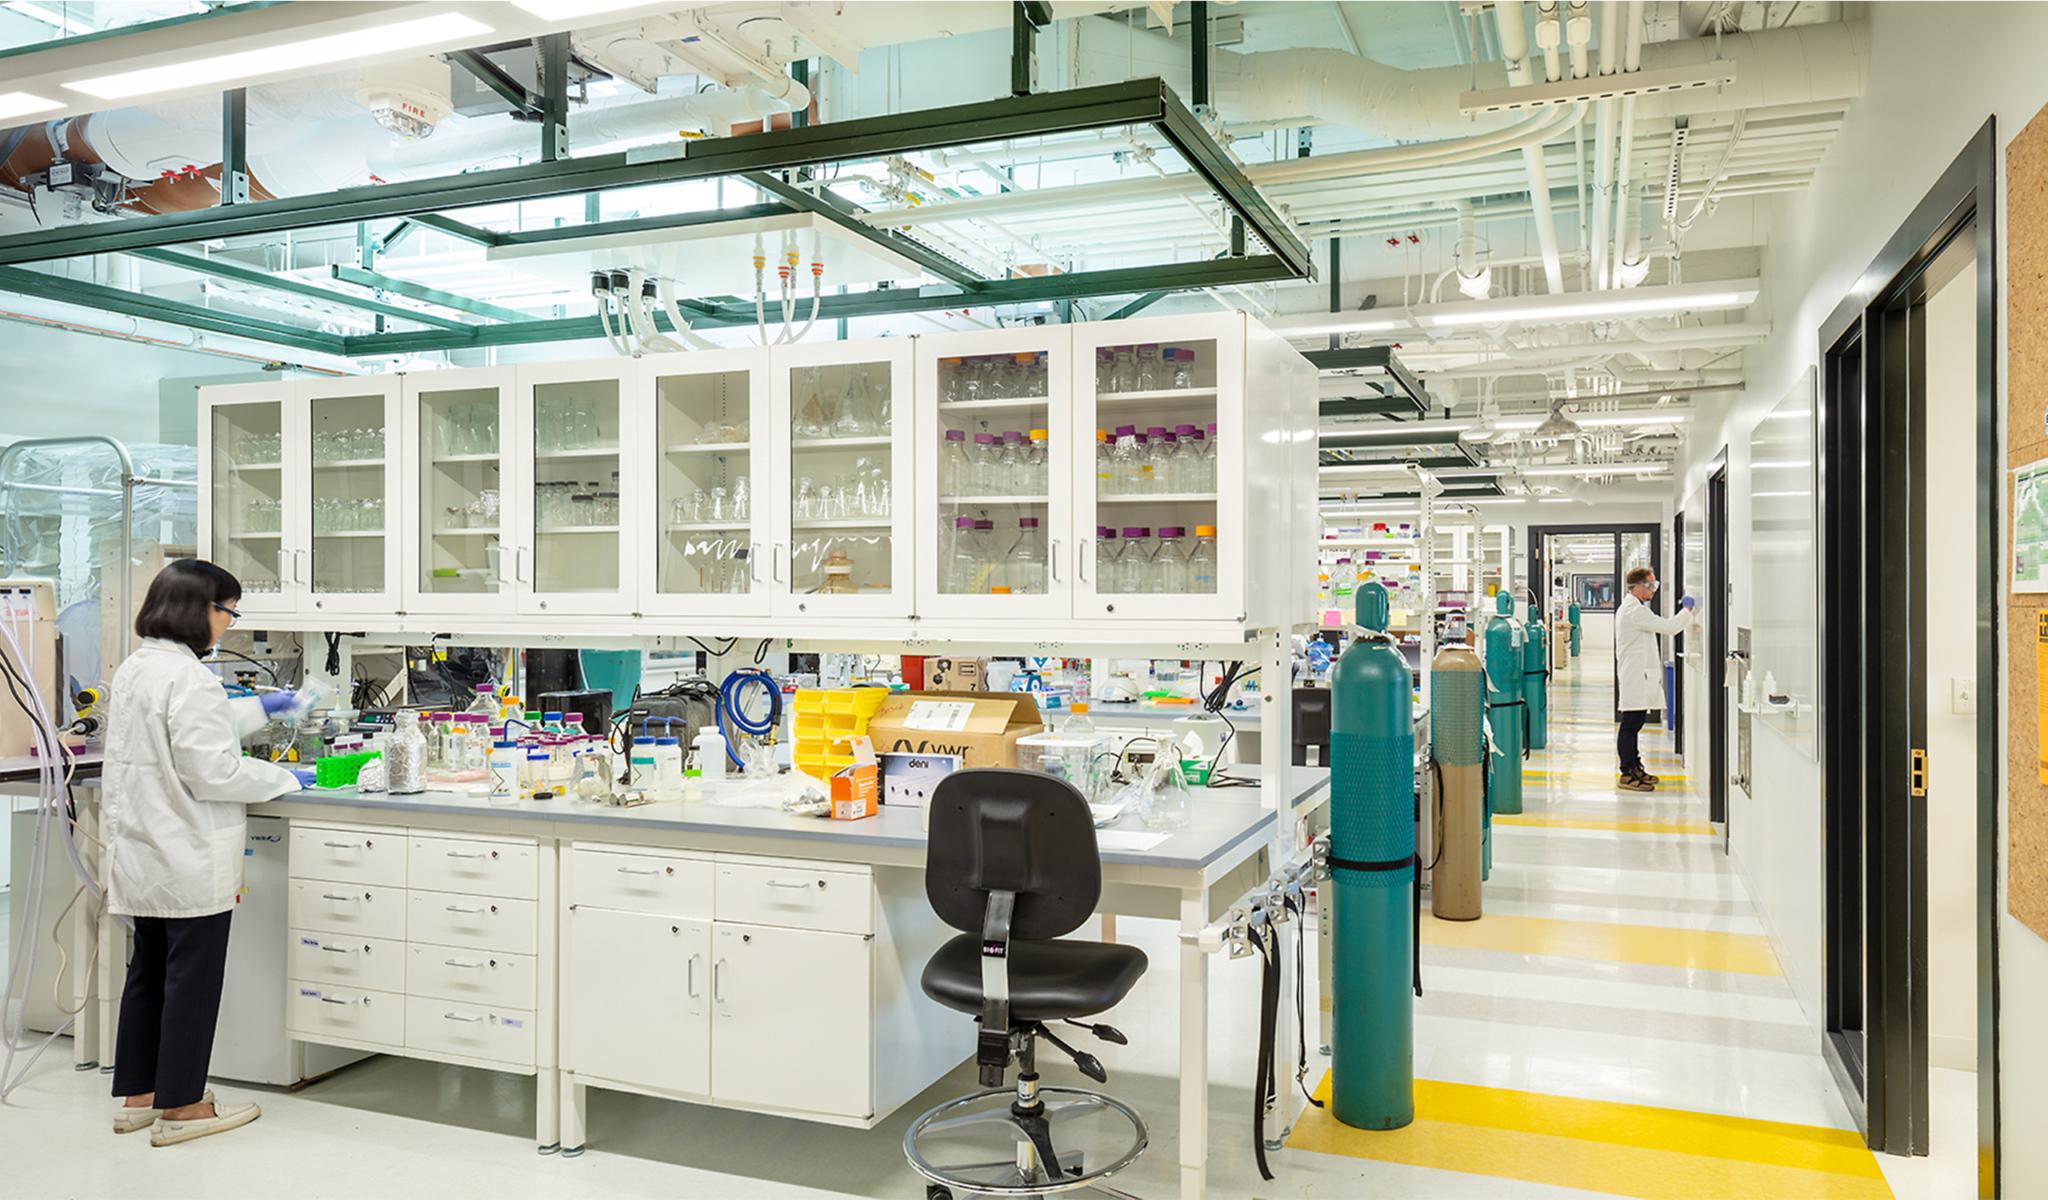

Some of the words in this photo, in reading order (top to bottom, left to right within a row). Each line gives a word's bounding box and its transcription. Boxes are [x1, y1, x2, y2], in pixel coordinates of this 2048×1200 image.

[402, 102, 425, 118] FIRE
[931, 744, 969, 759] vwr
[908, 758, 929, 768] deni
